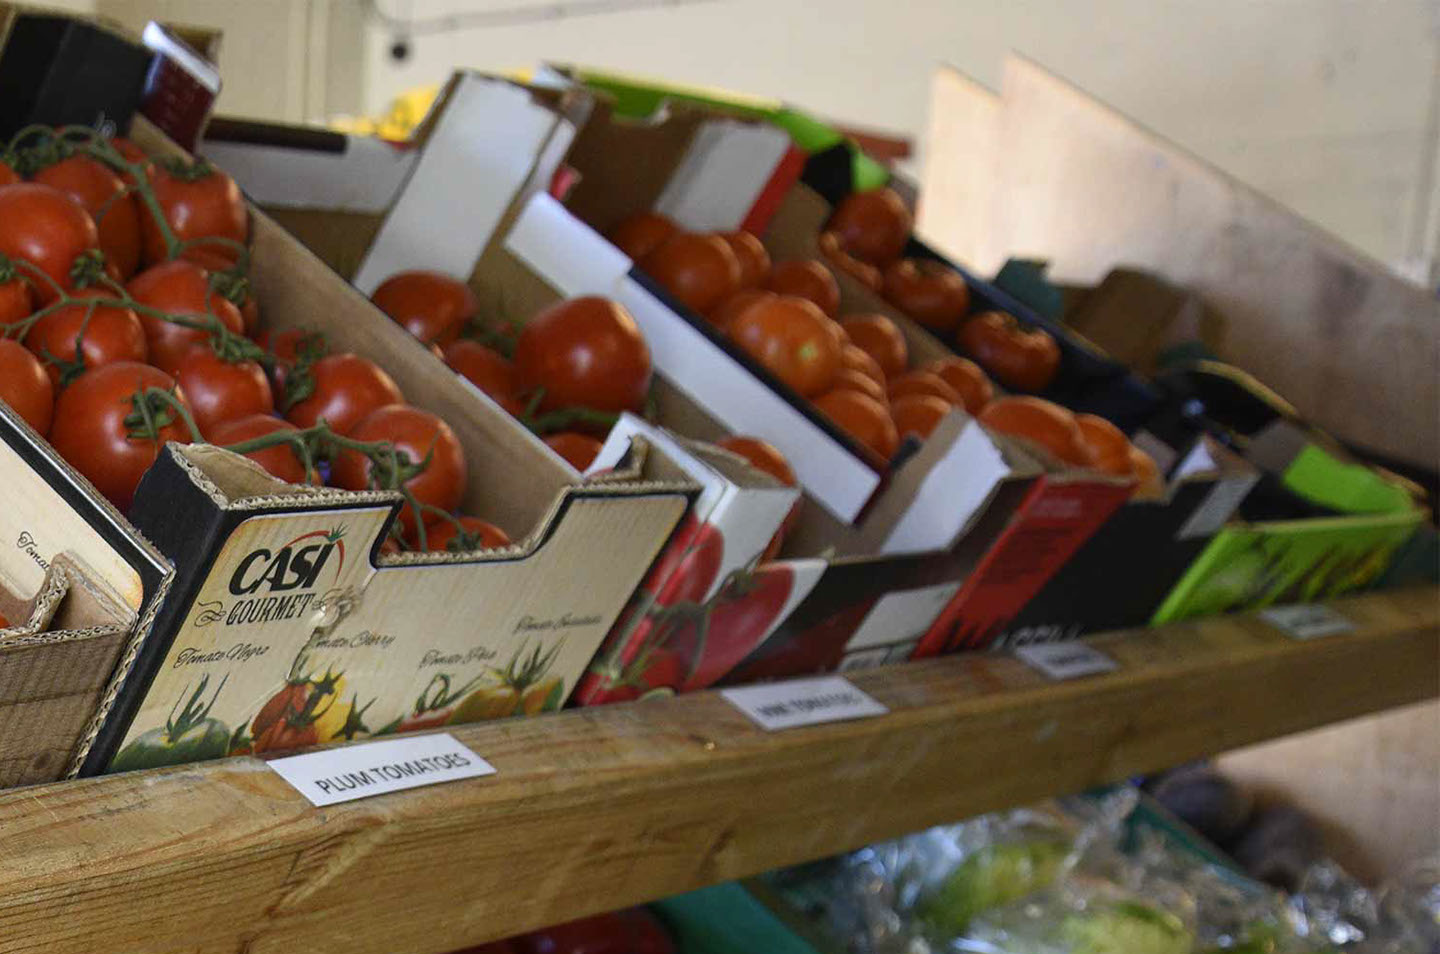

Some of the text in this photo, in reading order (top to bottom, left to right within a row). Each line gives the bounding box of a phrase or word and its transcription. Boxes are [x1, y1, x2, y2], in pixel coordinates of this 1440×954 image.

[228, 543, 336, 596] CASI
[225, 593, 317, 626] GOURMET
[315, 752, 472, 795] PLUM TOMATOES
